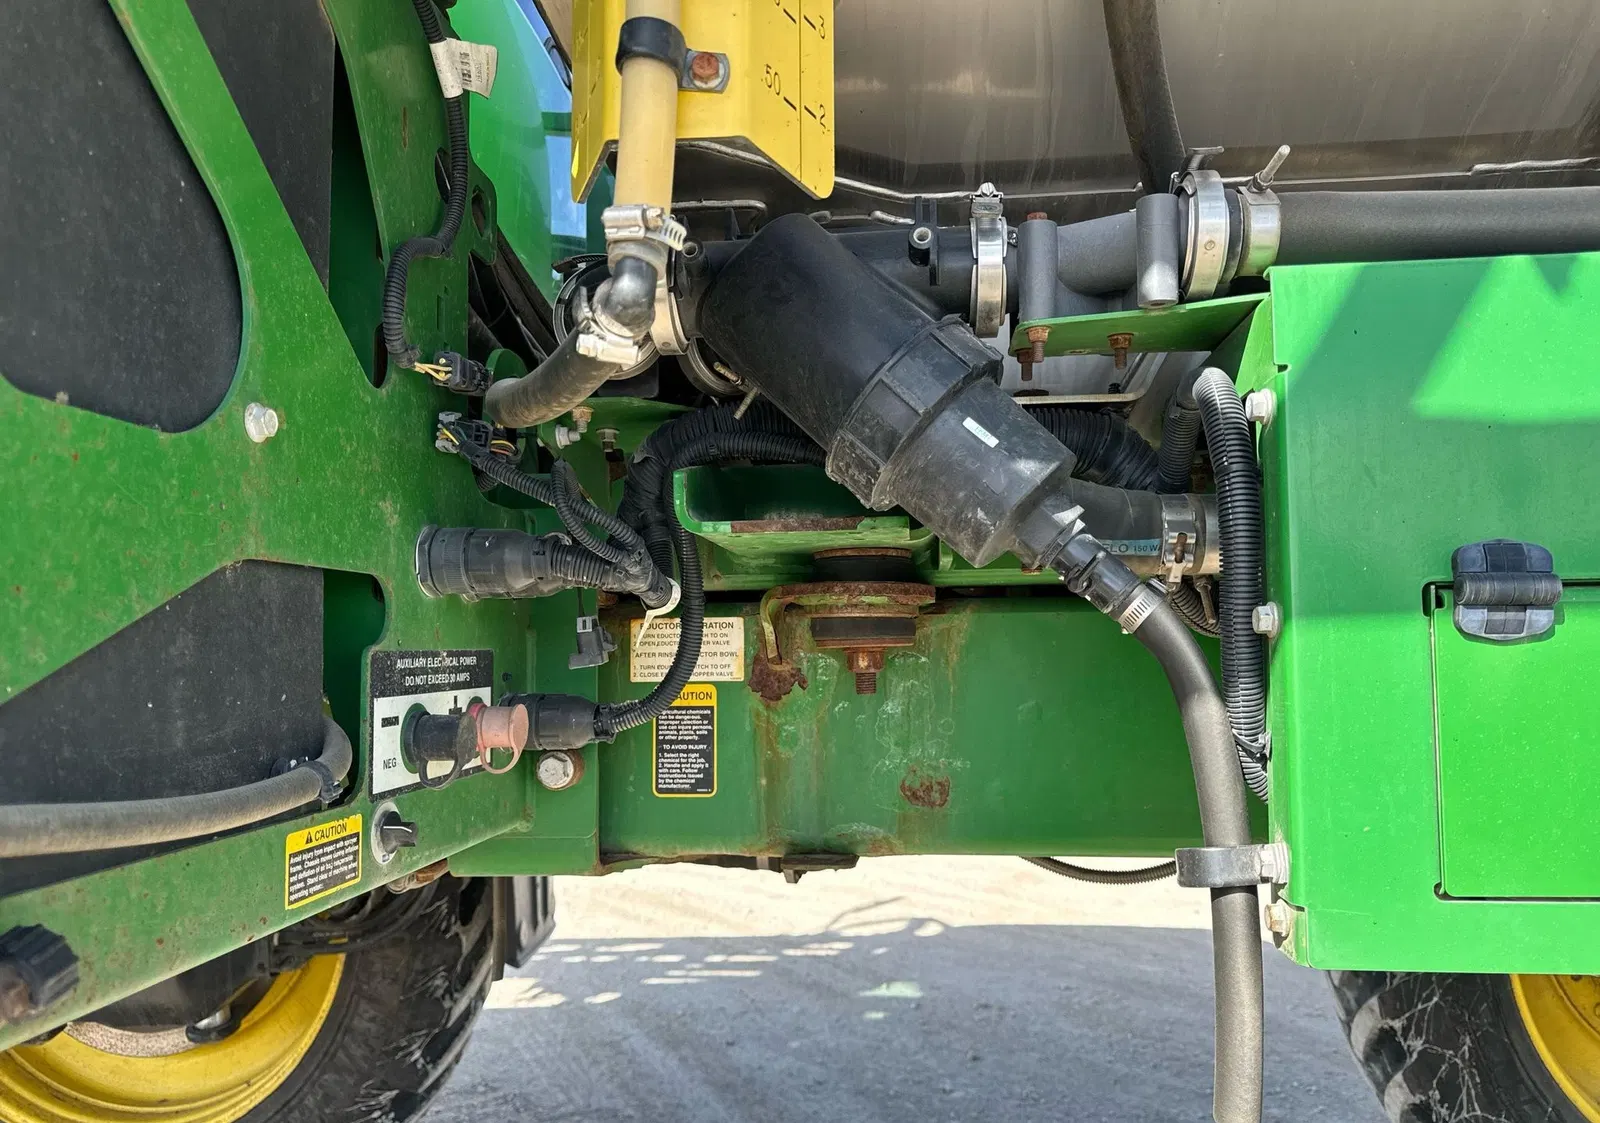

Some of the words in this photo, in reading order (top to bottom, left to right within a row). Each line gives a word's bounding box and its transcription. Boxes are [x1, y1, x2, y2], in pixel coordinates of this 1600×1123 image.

[818, 15, 826, 40] 3
[765, 64, 780, 96] 50
[819, 104, 826, 128] 2
[396, 657, 426, 669] AUXILIARY
[460, 656, 477, 666] POWER
[406, 676, 415, 686] DO
[415, 675, 427, 685] NOT
[428, 673, 450, 684] EXCEED
[456, 672, 471, 682] AMPS
[383, 757, 397, 770] NEG
[314, 822, 347, 841] CAUTION
